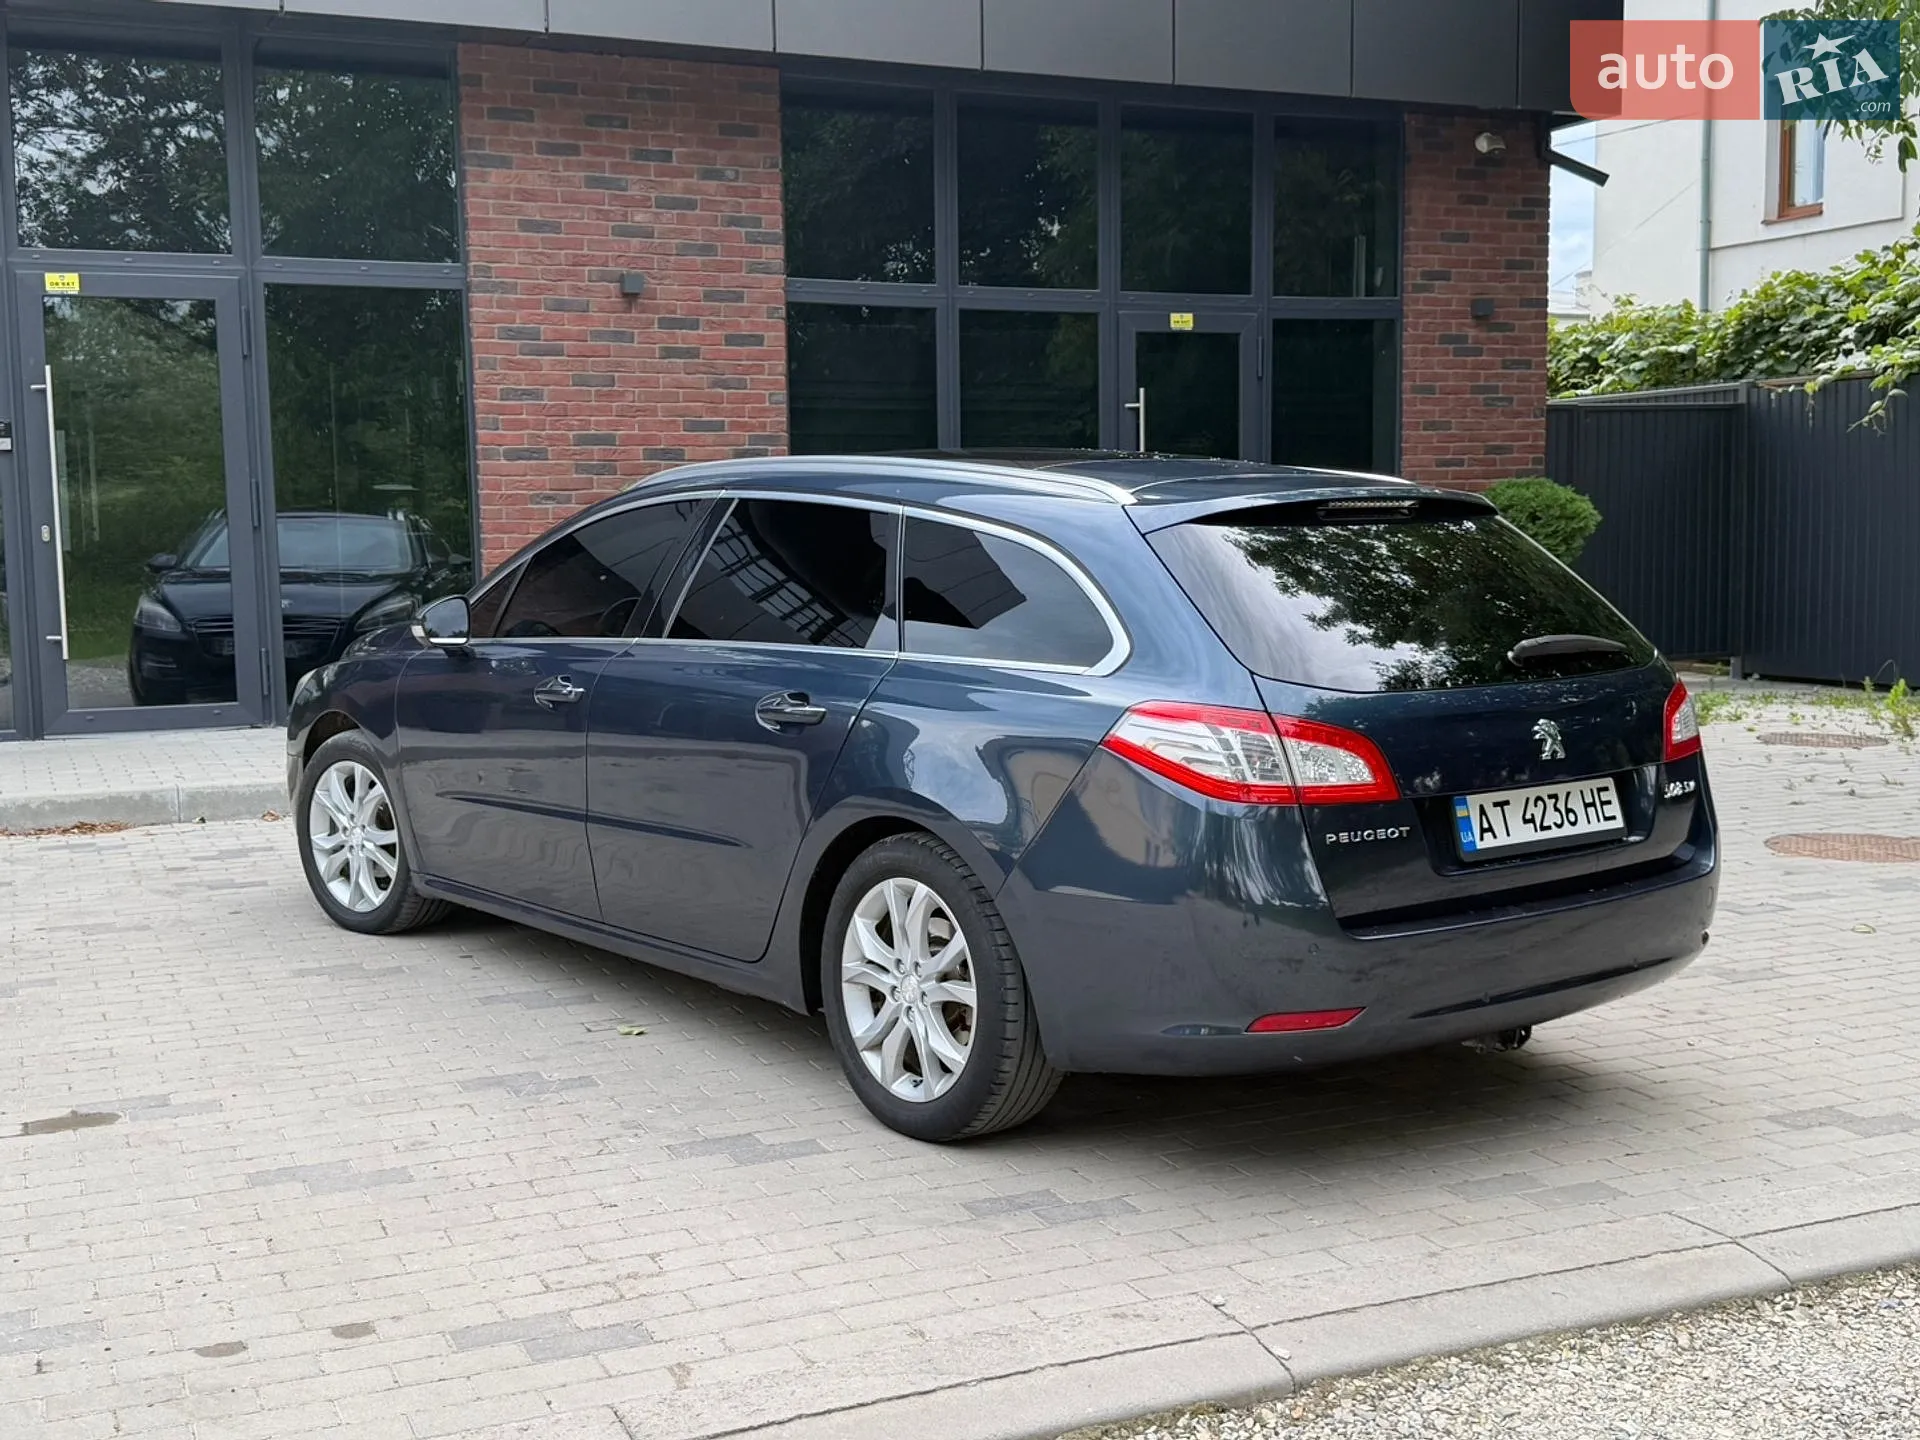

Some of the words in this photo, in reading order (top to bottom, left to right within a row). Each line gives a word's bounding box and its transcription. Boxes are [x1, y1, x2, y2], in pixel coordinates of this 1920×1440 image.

[1478, 799, 1511, 842] AT
[1521, 791, 1579, 833] 4236
[1579, 786, 1617, 825] HE
[1325, 826, 1411, 845] PEUGEOT
[1460, 832, 1475, 843] UA
